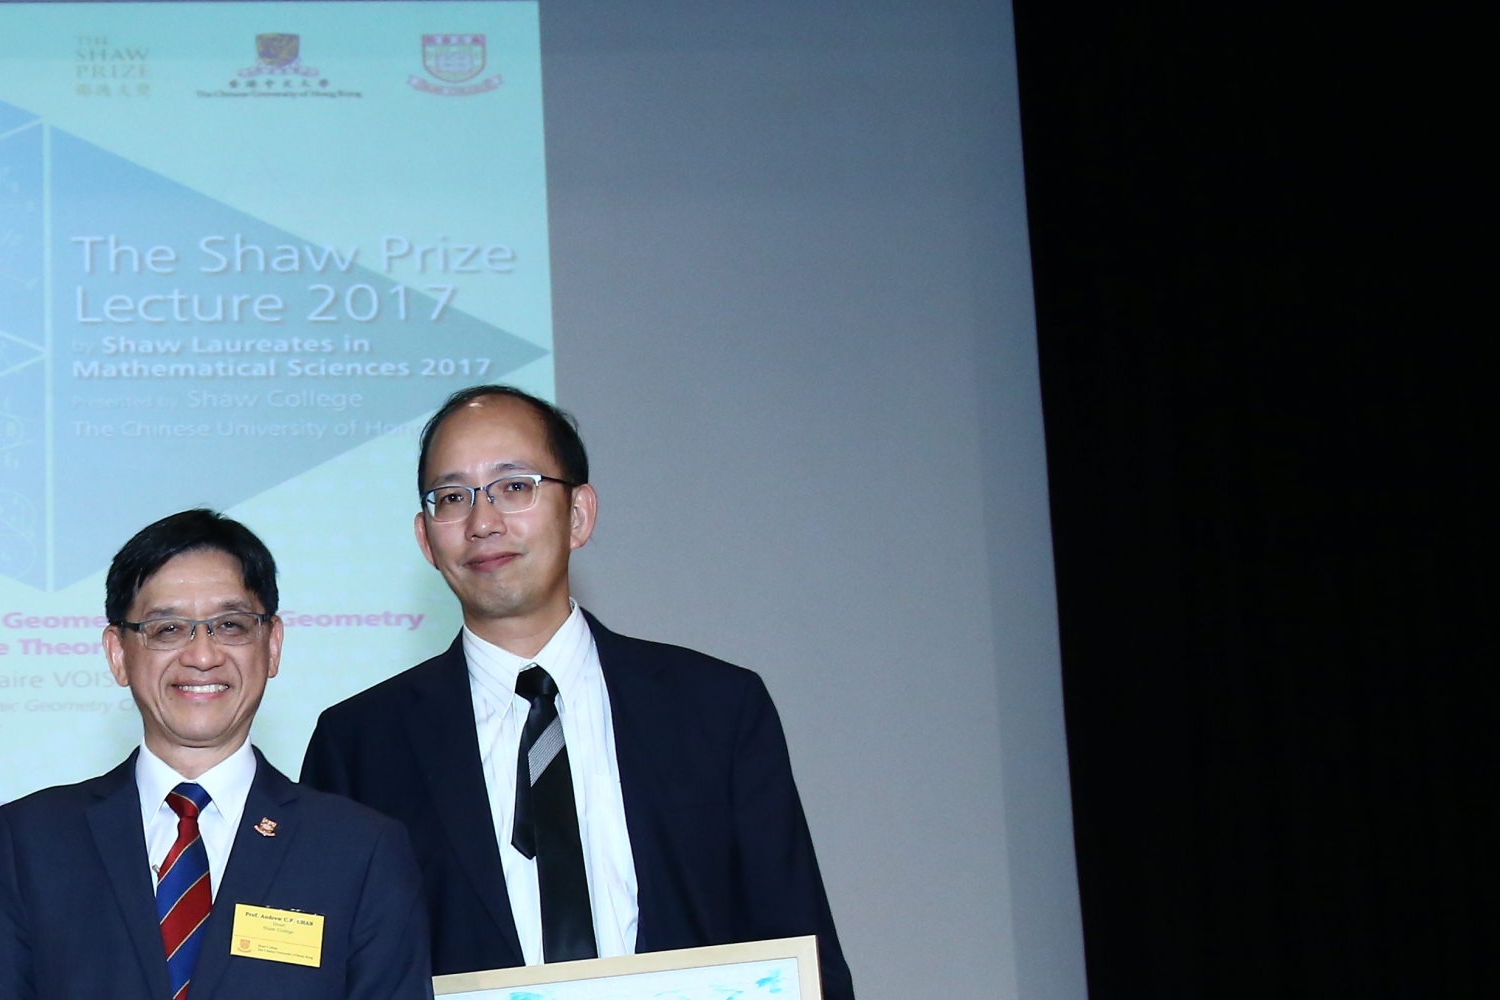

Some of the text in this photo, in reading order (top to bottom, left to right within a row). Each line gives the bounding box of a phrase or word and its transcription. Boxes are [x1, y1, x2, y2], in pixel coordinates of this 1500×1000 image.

[75, 47, 150, 62] SHAW
[76, 65, 150, 79] PRIZE
[71, 234, 517, 275] The Shaw Prize
[75, 283, 456, 325] Lecture 2017
[102, 336, 181, 354] Shaw
[192, 335, 333, 353] Laureates
[344, 334, 370, 352] in
[72, 359, 491, 378] Mathematical Sciences 2017
[187, 389, 258, 408] Shaw
[267, 389, 363, 411] College
[74, 421, 114, 437] The
[122, 421, 210, 437] Chinese
[217, 420, 326, 440] University
[334, 419, 357, 436] of
[2, 611, 107, 629] Geome
[279, 610, 425, 631] Geometry
[17, 638, 102, 656] Theor
[52, 670, 113, 688] VOIS
[24, 700, 114, 716] Geometry
